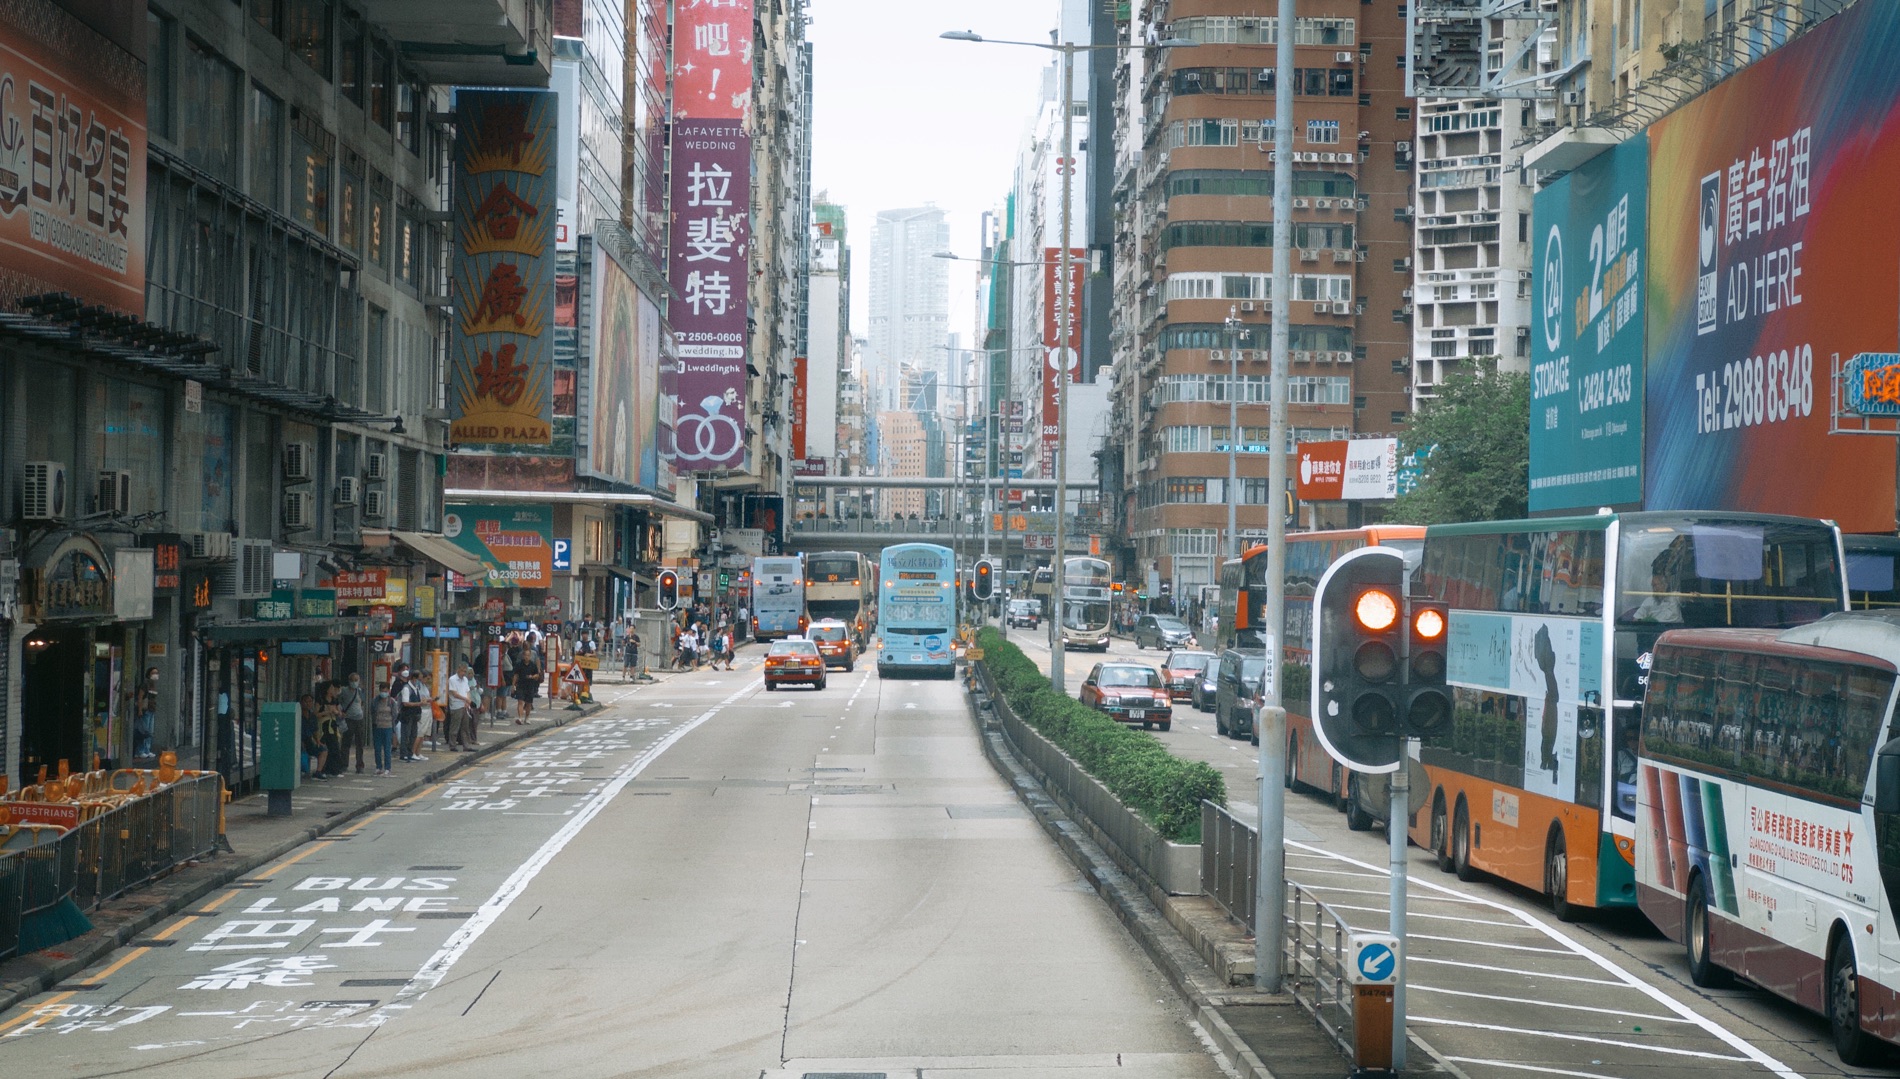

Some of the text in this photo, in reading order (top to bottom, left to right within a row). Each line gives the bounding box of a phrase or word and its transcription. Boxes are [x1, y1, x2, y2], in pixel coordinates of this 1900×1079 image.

[677, 127, 745, 137] LAFAYETTE
[685, 141, 736, 150] WEDDING
[29, 79, 130, 240] 百好名宴
[1725, 126, 1811, 246] 廣告招租
[30, 210, 49, 243] VERY
[51, 217, 72, 250] GOOD
[684, 161, 733, 315] 拉斐特
[1547, 258, 1559, 318] 24
[1699, 275, 1711, 295] EASY
[1726, 241, 1802, 325] AD HERE
[1699, 296, 1716, 322] GROUP
[688, 332, 742, 342] 2506-0606
[679, 346, 740, 357] -wedding.hk
[687, 363, 741, 375] Lweddinghk
[1534, 355, 1569, 399] STORAGE
[1584, 363, 1631, 412] 2424 2433
[1697, 370, 1720, 434] Tel:
[1723, 355, 1764, 430] 2988
[1767, 343, 1813, 423] 8348
[452, 425, 549, 439] ALLIED PLAZA
[1312, 460, 1341, 475] 蘋果迷你倉
[554, 541, 568, 560] P
[500, 571, 542, 579] 2399 6343
[488, 626, 502, 635] S8
[546, 624, 558, 632] S9
[374, 640, 390, 652] S7
[1841, 863, 1854, 884] CTS
[292, 877, 458, 891] BUS
[241, 897, 459, 913] LANE
[185, 919, 417, 951] 巴士
